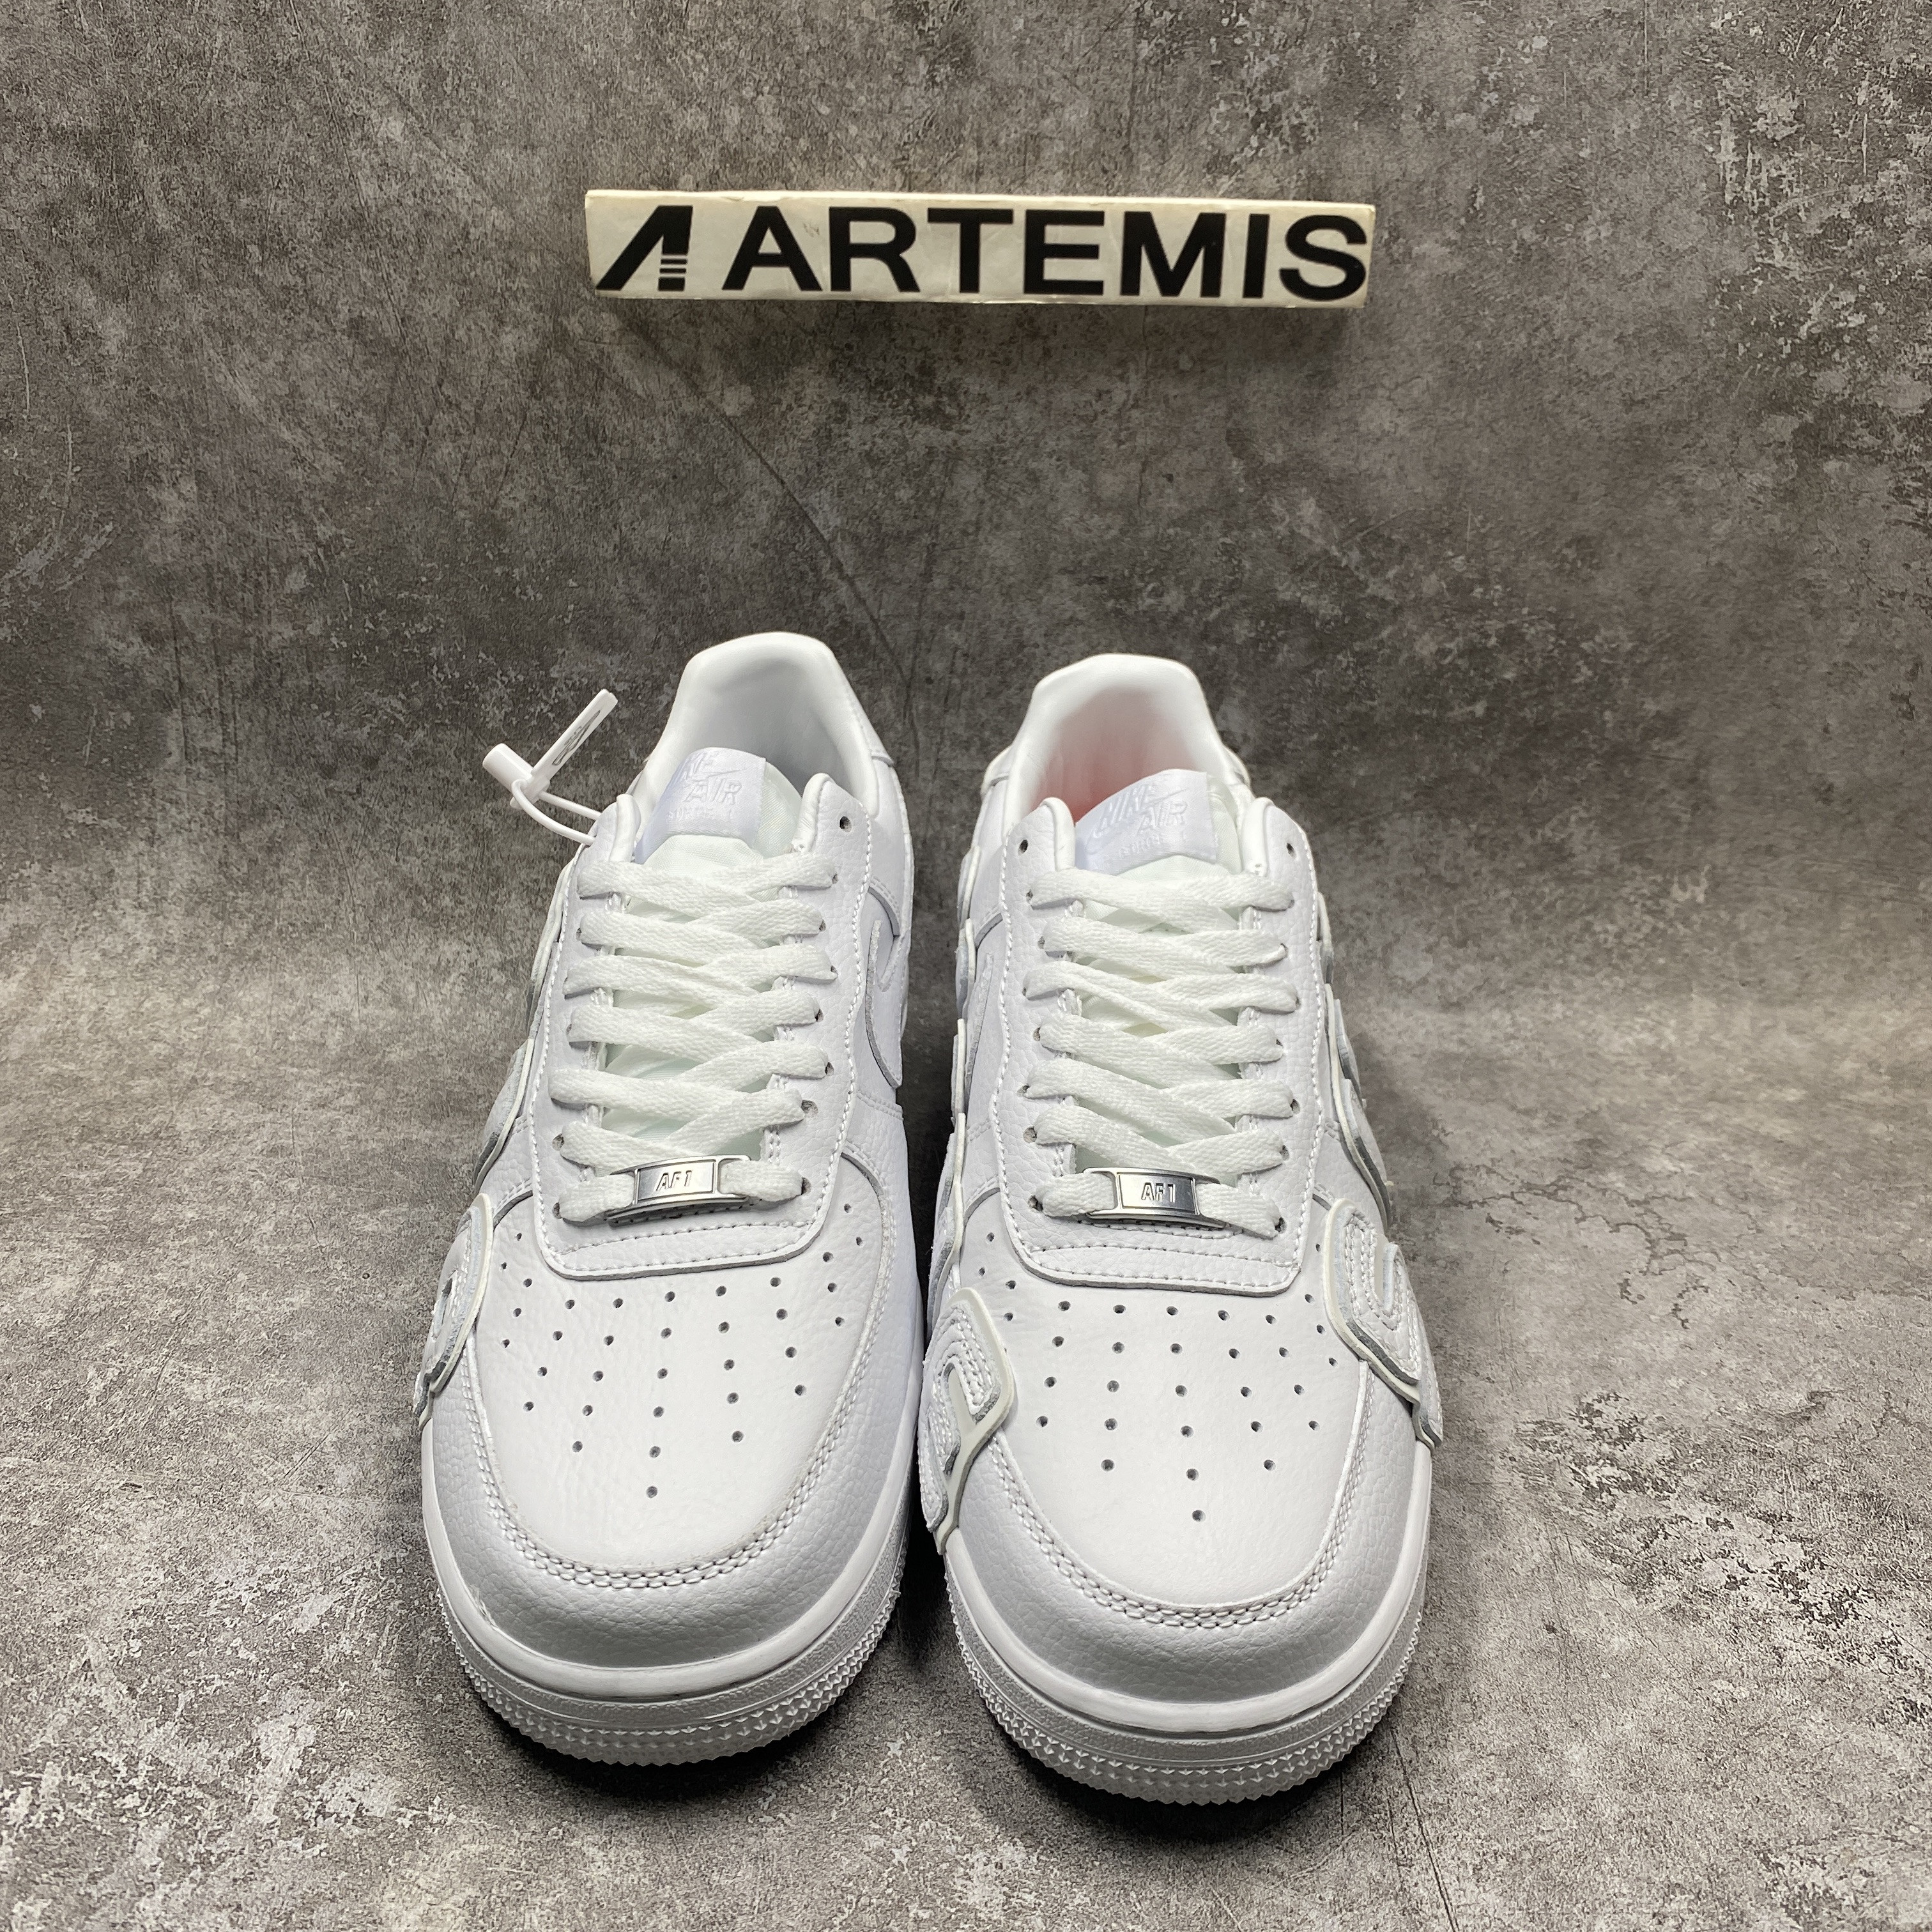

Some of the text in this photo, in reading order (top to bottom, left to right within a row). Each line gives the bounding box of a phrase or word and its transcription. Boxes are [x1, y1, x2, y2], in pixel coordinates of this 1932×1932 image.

[721, 204, 1367, 302] ARTEMIS
[683, 777, 742, 806] AIR
[654, 1169, 693, 1192] AF1
[1140, 1181, 1176, 1204] AF1
